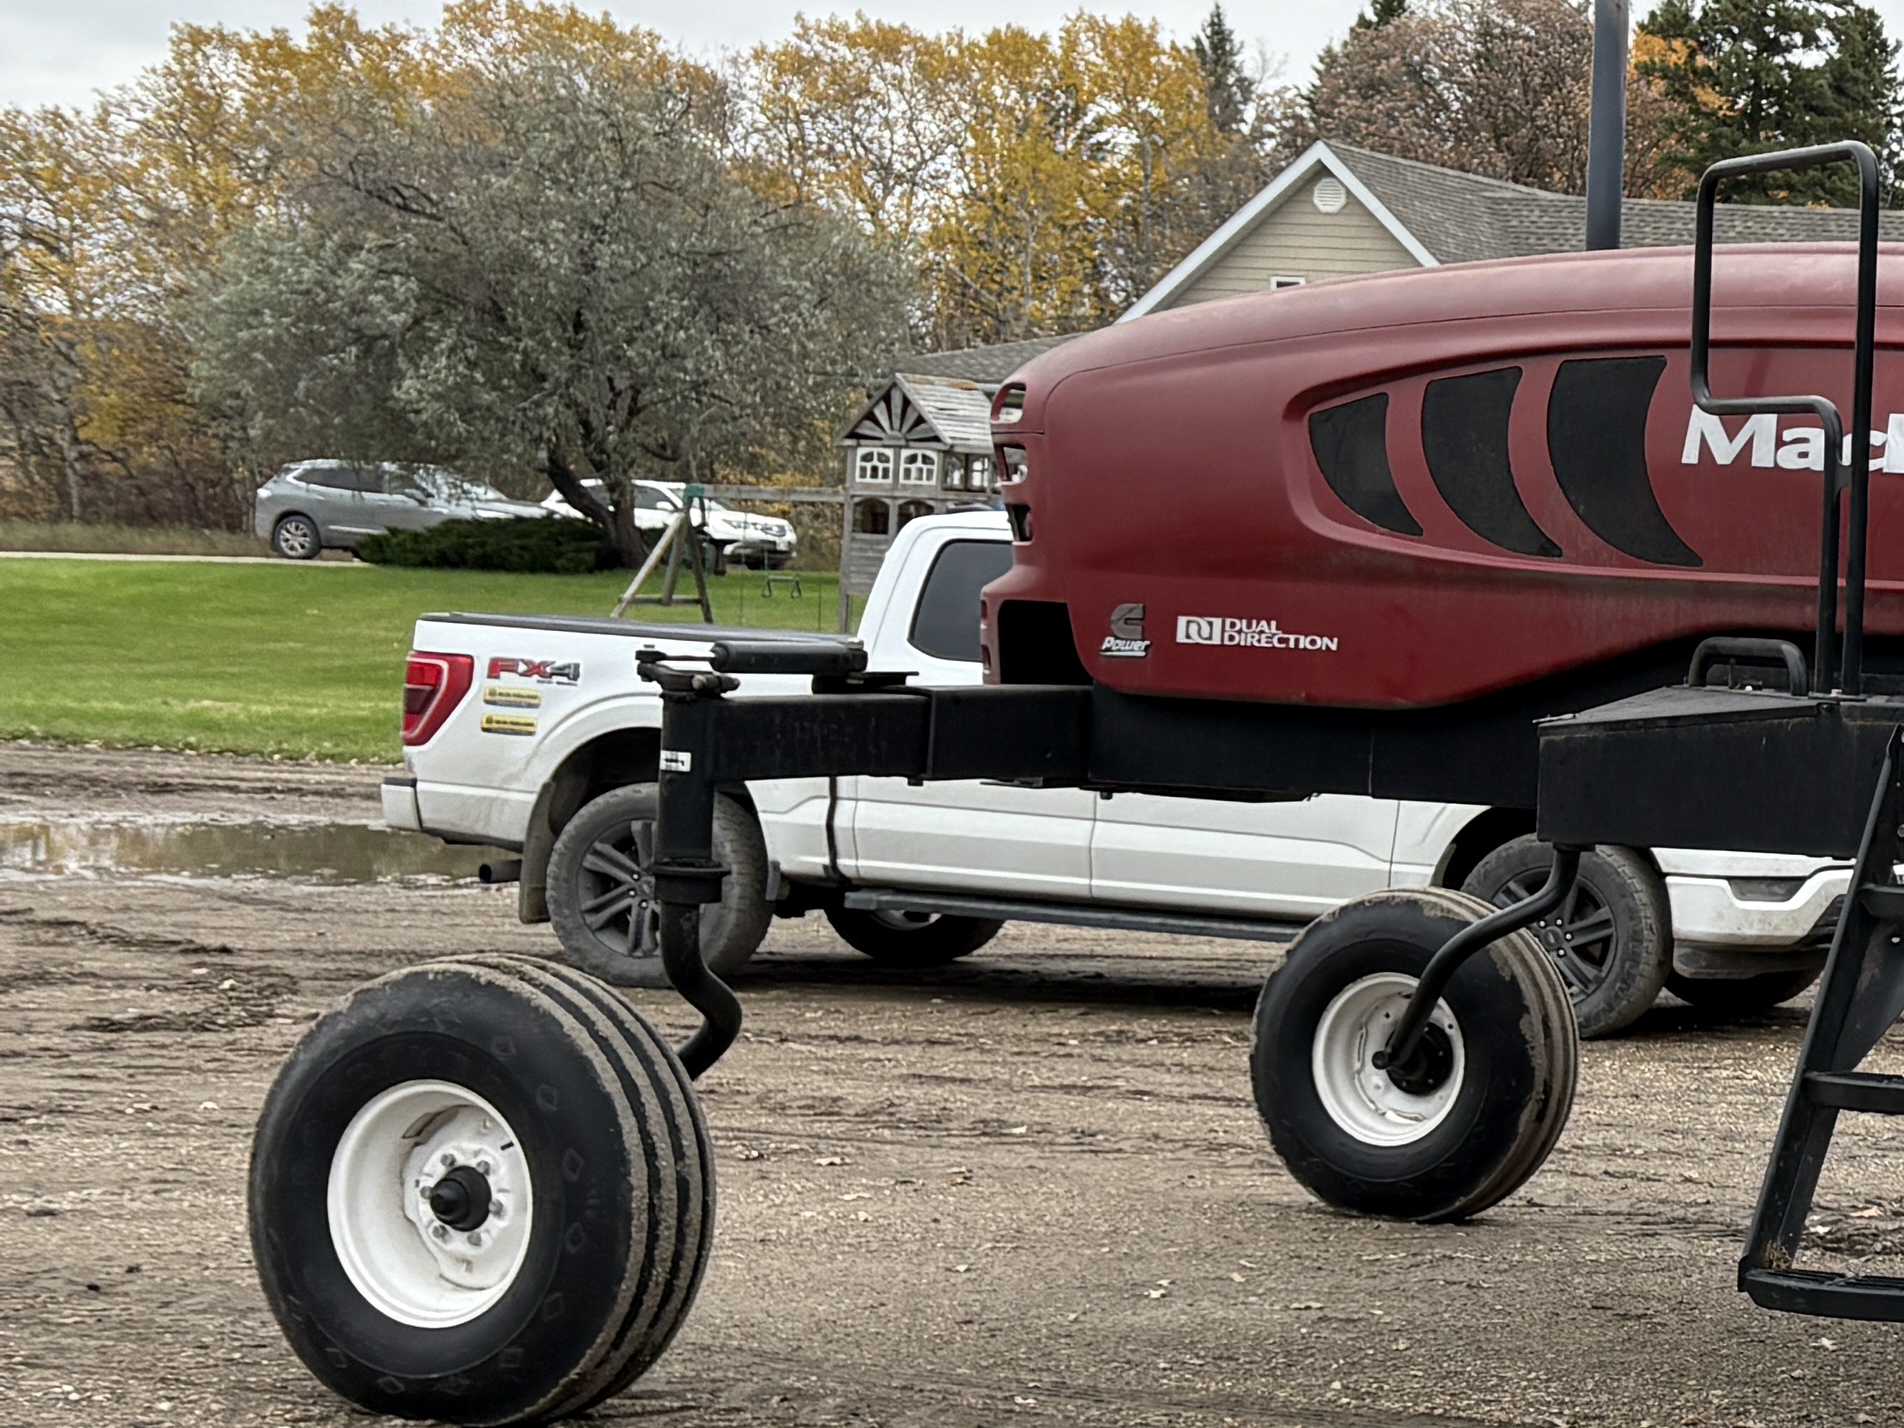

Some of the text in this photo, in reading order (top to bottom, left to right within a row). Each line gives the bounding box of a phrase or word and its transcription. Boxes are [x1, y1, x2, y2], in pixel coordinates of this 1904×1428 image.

[1224, 618, 1282, 634] DUAL
[1101, 637, 1150, 651] Power
[1223, 632, 1338, 651] DIRECTION
[487, 657, 580, 681] FX4
